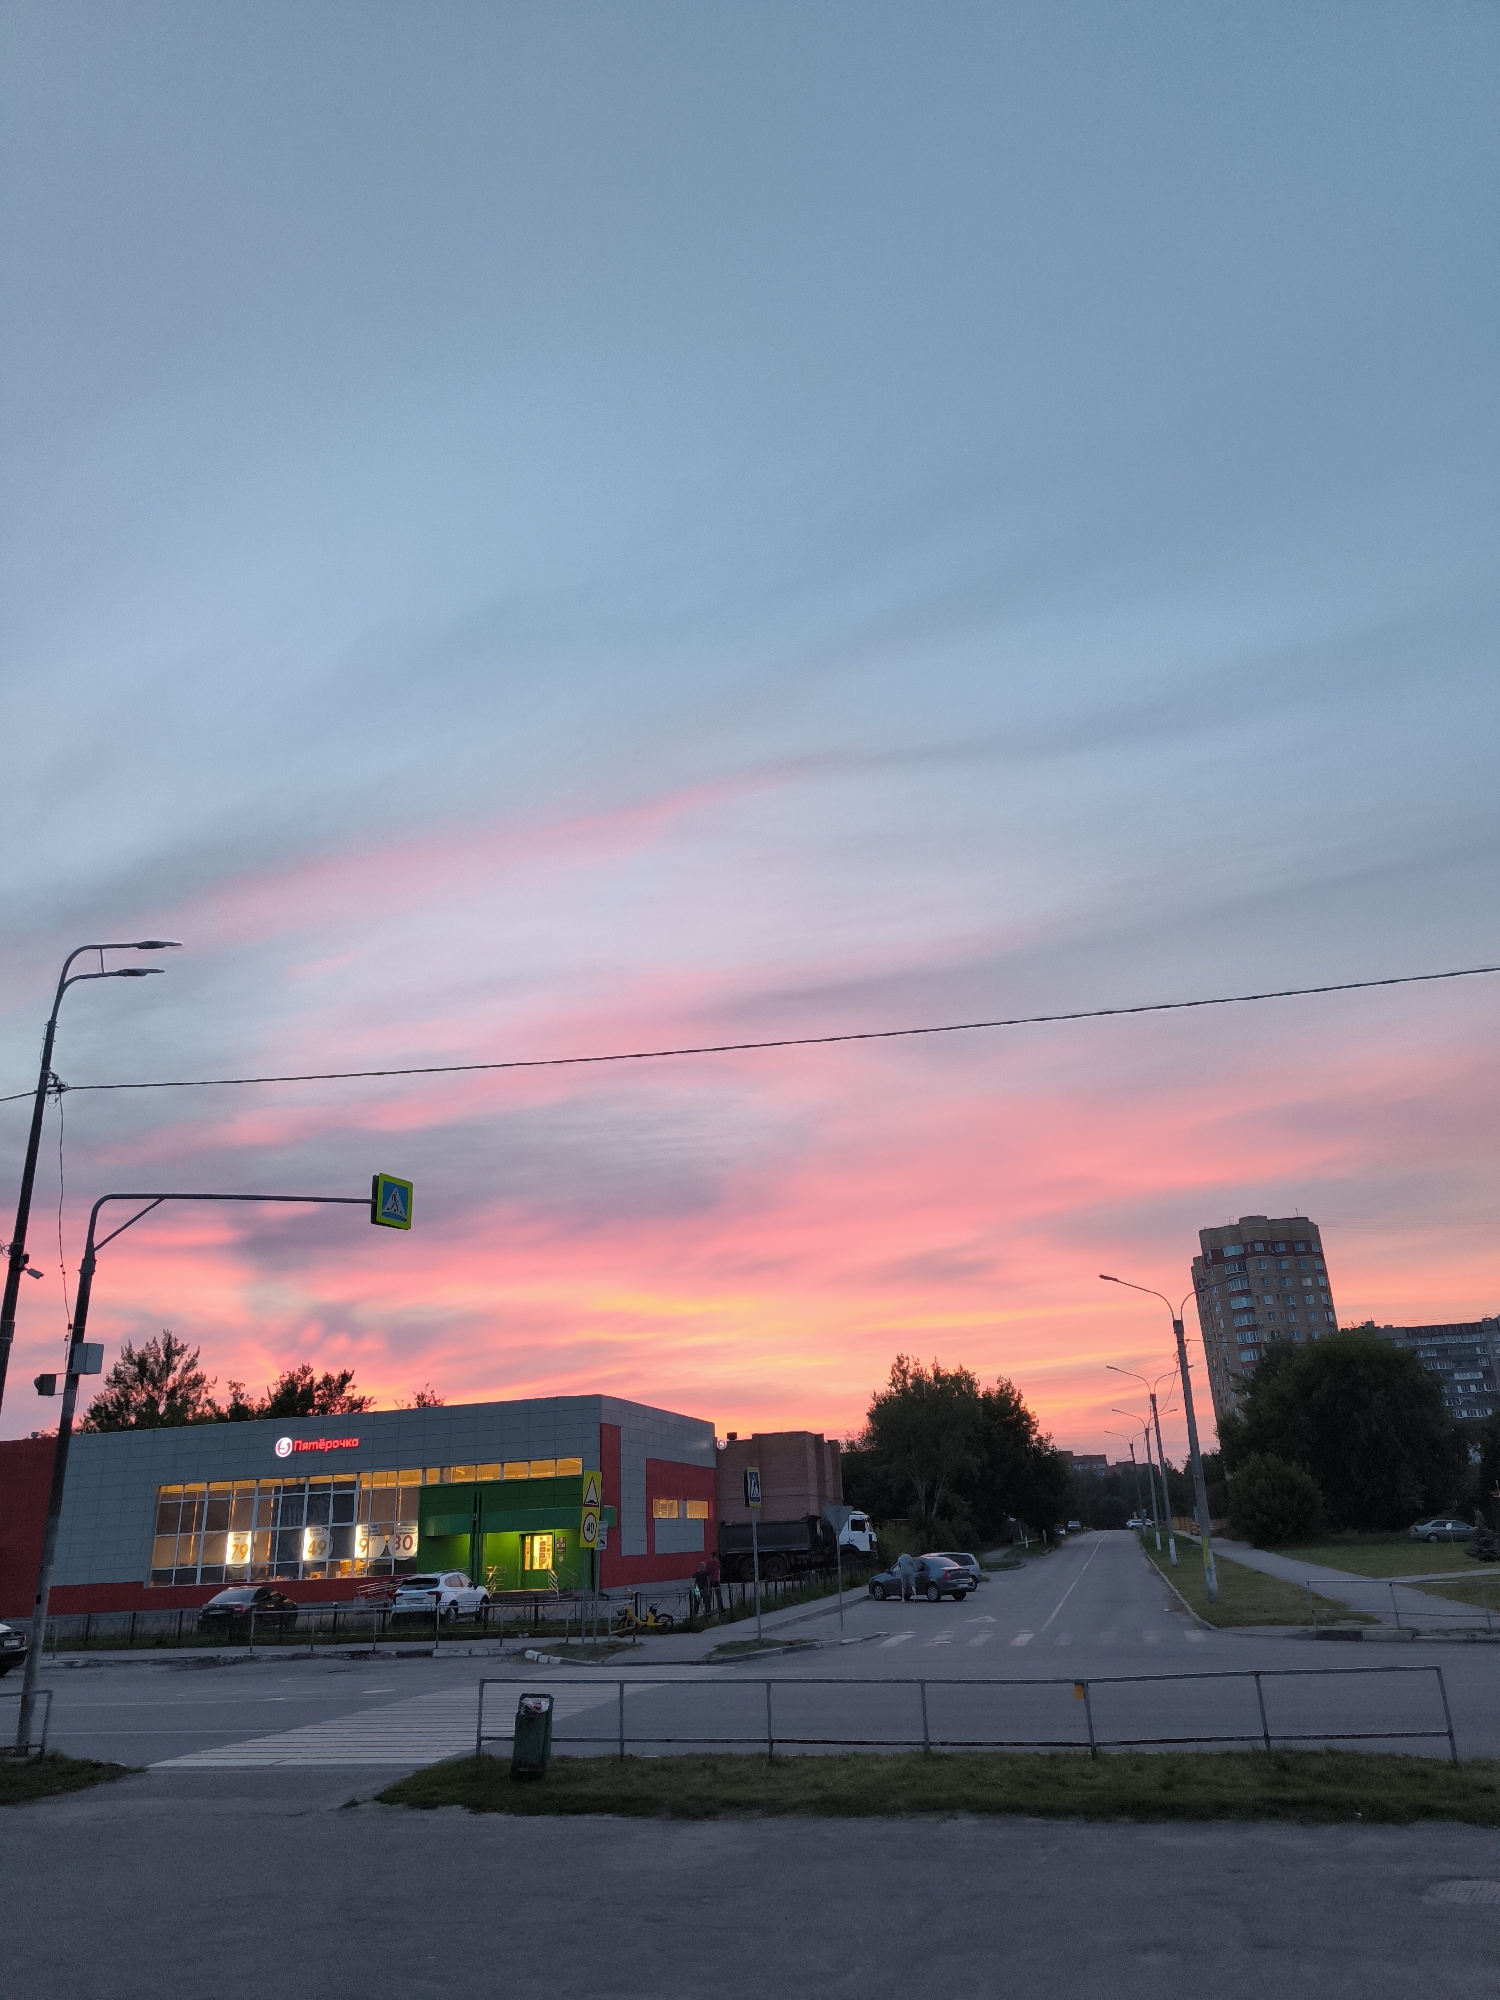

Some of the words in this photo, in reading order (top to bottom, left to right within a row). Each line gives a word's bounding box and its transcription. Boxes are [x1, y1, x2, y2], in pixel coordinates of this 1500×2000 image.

[293, 1438, 360, 1452] Пятёрочка
[586, 1521, 595, 1534] 40
[231, 1543, 249, 1560] 79
[307, 1539, 328, 1556] 49
